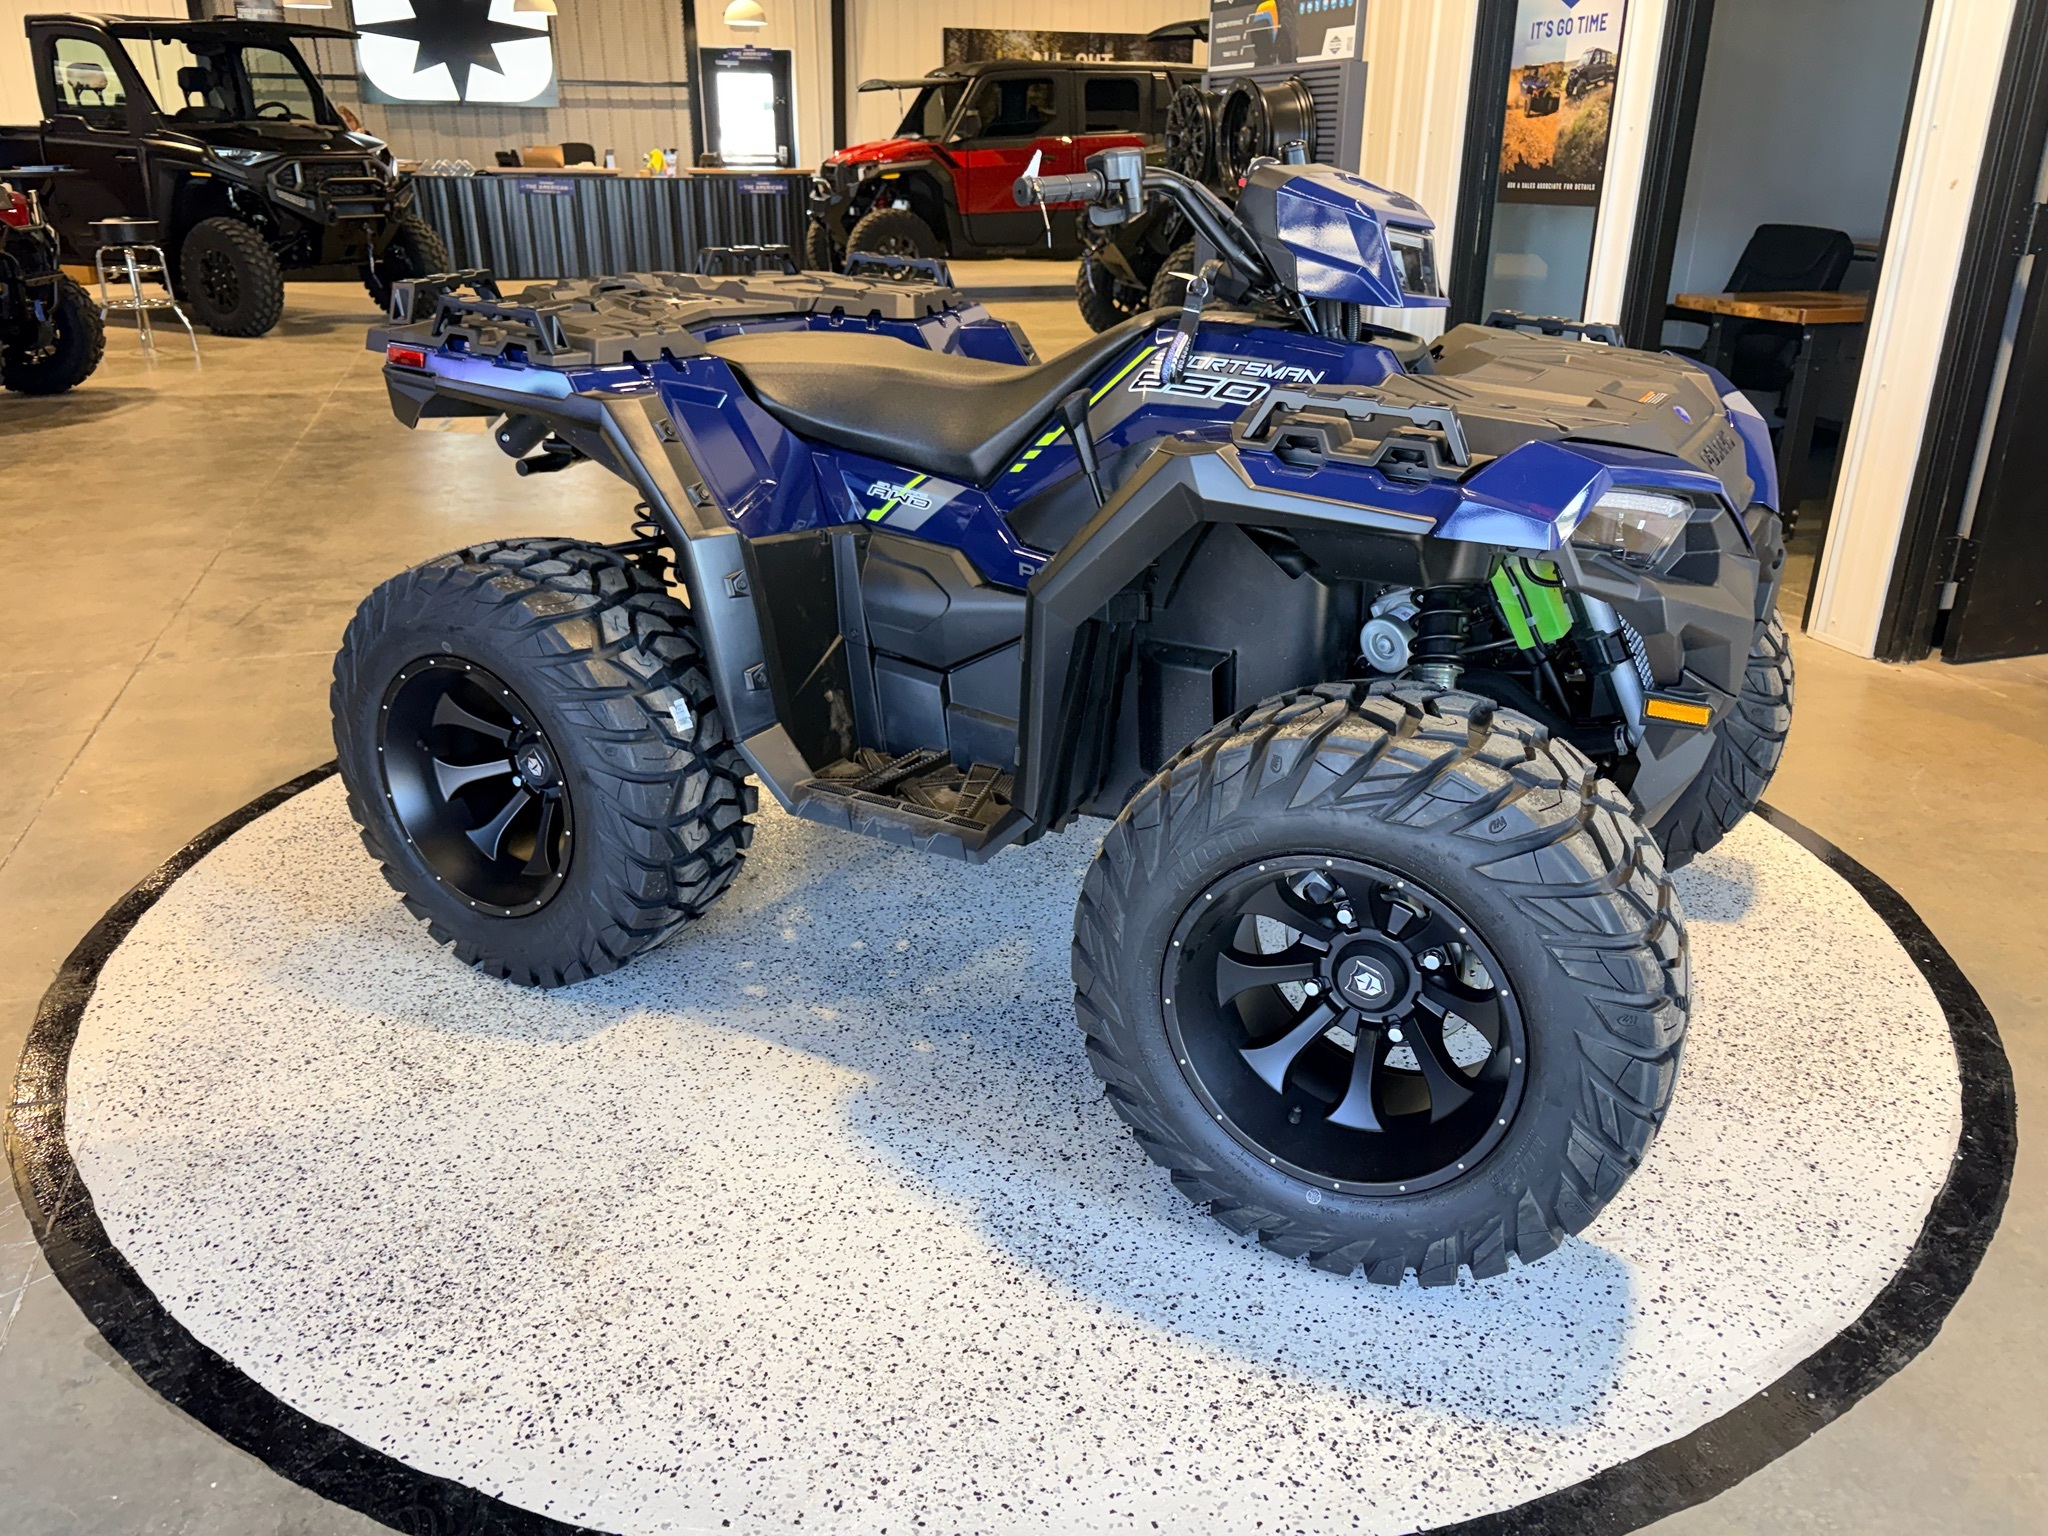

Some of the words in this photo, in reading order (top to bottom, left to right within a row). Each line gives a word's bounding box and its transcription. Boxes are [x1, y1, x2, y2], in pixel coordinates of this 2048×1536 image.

[1531, 20, 1554, 40] IT'S
[1557, 18, 1574, 36] GO
[1578, 13, 1609, 34] TIME
[1506, 181, 1516, 189] ASK
[1521, 182, 1536, 190] SALES
[1536, 182, 1562, 190] ASSOCIATE
[1563, 183, 1573, 191] FOR
[1574, 183, 1596, 191] DETAILS
[1150, 352, 1326, 385] ORTSMAN
[866, 484, 932, 510] AWD
